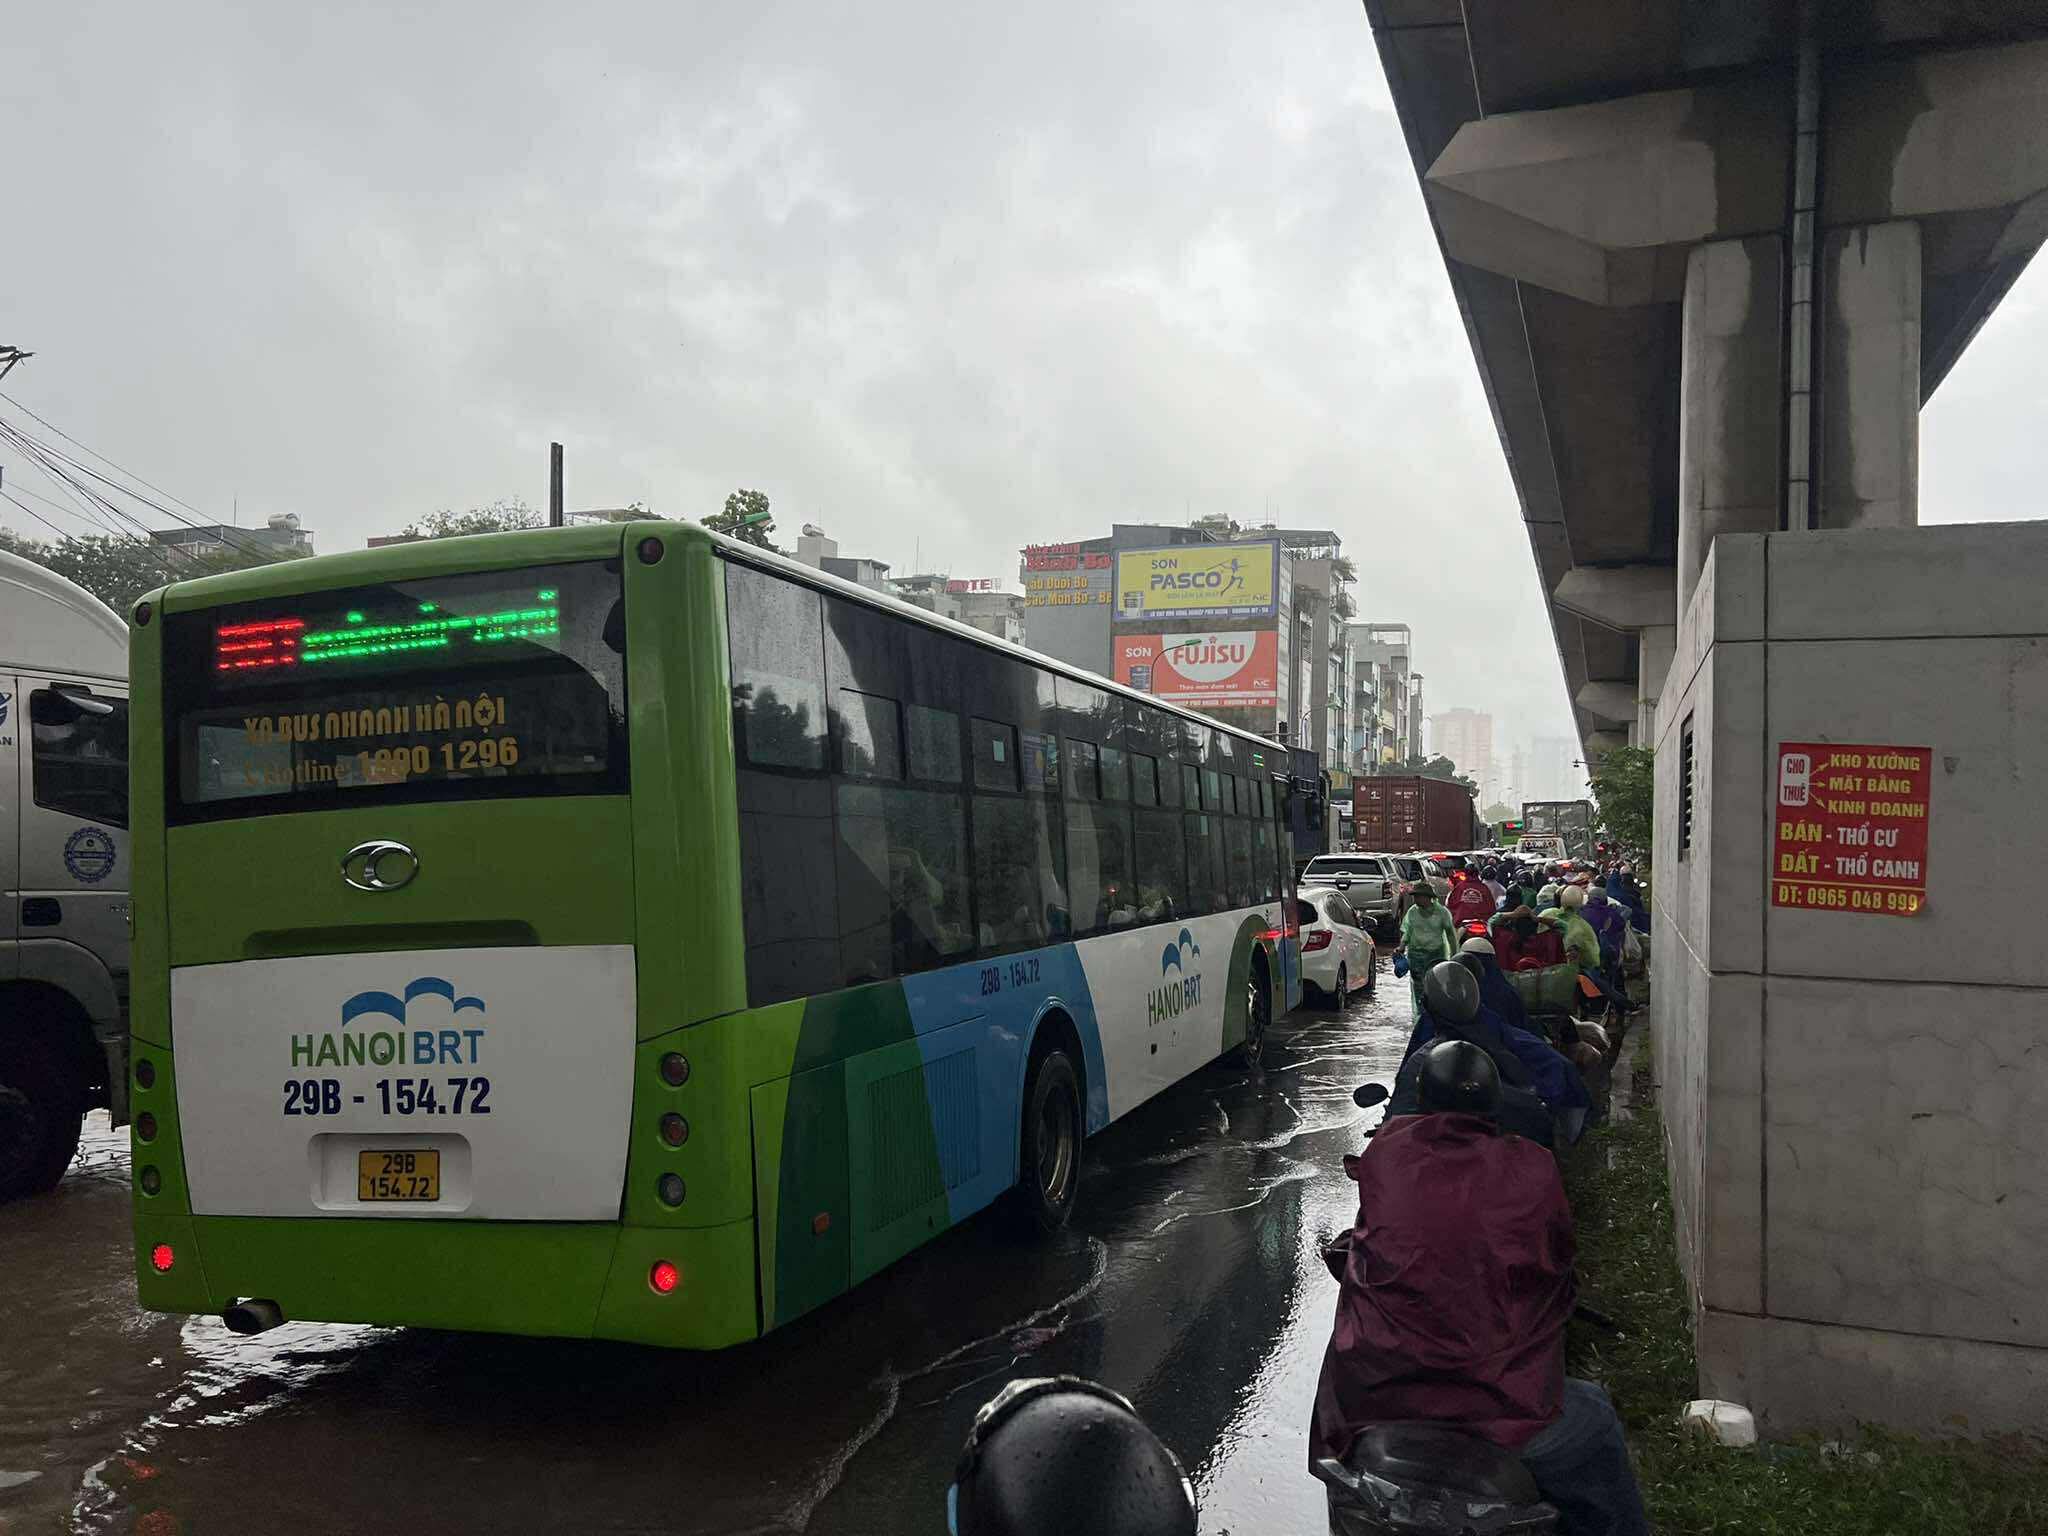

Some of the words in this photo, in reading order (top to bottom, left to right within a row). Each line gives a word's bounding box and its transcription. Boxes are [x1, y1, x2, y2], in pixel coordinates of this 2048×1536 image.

[1151, 571, 1222, 590] PASCO
[1126, 645, 1152, 658] SƠN
[278, 713, 320, 742] BUS
[325, 706, 409, 739] NHANH
[416, 695, 450, 732] HÀ
[455, 692, 505, 734] NỘI
[441, 737, 518, 771] 1296
[1830, 753, 1862, 768] KHO
[1866, 752, 1921, 771] XƯỞNG
[1786, 757, 1805, 774] CHO
[1783, 781, 1806, 802] THUÊ
[1829, 776, 1864, 794] MẶT
[1866, 774, 1912, 794] BẰNG
[1828, 800, 1865, 816] KINH
[1870, 802, 1924, 818] DOANH
[1780, 819, 1823, 842] BÁN
[1837, 821, 1871, 846] THỔ
[1874, 828, 1899, 848] CƯ
[1780, 847, 1820, 874] ĐẤT
[1836, 852, 1869, 876] THỔ
[1872, 860, 1920, 880] CANH
[1778, 885, 1802, 904] ĐT:
[1807, 887, 1847, 907] 0965
[1852, 890, 1882, 909] 048
[1888, 892, 1918, 912] 999
[981, 966, 1000, 996] 29B
[1010, 958, 1040, 989] 154.72
[283, 1079, 342, 1116] 29B
[376, 1076, 491, 1116] 154.72
[382, 1154, 416, 1175] 29B
[369, 1178, 431, 1199] 154.72
